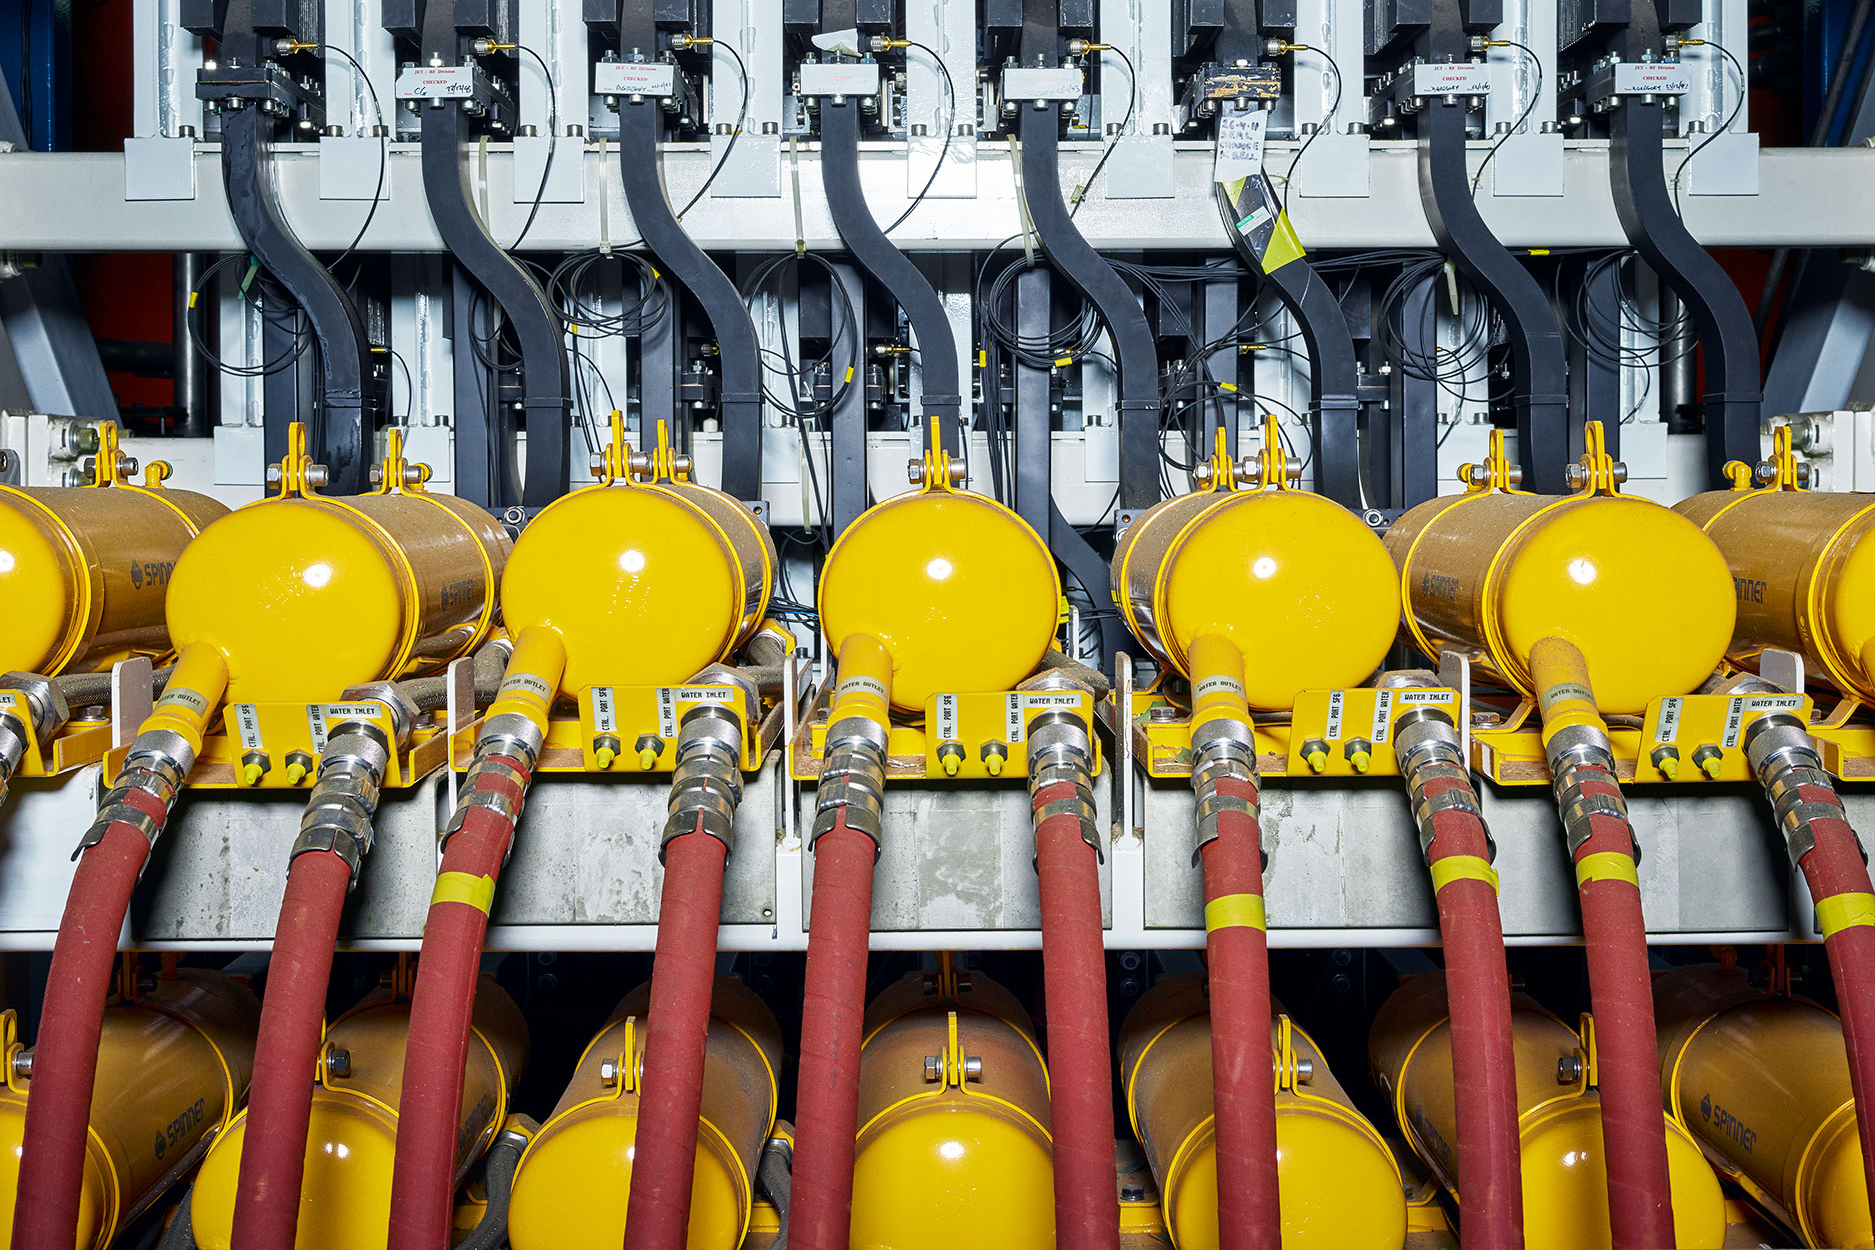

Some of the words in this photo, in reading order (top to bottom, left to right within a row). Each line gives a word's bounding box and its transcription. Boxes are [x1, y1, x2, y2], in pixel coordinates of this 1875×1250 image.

[144, 561, 176, 586] SPINN
[524, 678, 546, 692] OUTLET
[841, 681, 860, 691] WATER
[863, 681, 884, 694] OUTLET
[1198, 681, 1217, 692] WATER
[1220, 681, 1242, 692] OUTLET
[177, 694, 201, 706] OUTLET
[661, 688, 670, 704] WATER
[1010, 693, 1018, 710] WATER
[1380, 691, 1390, 708] WATER
[311, 704, 320, 720] WATER
[599, 699, 608, 713] PORT
[1732, 697, 1743, 714] WATER
[663, 706, 672, 719] PORT
[943, 707, 952, 720] PORT
[1010, 712, 1019, 724] PORT
[1330, 706, 1340, 719] PORT
[1378, 710, 1387, 723] PORT
[1665, 711, 1674, 724] PORT
[243, 717, 253, 730] PORT
[313, 723, 323, 735] PORT
[1729, 716, 1739, 729] PORT
[167, 1097, 205, 1148] SPINNER
[1714, 1105, 1757, 1154] SPINNER
